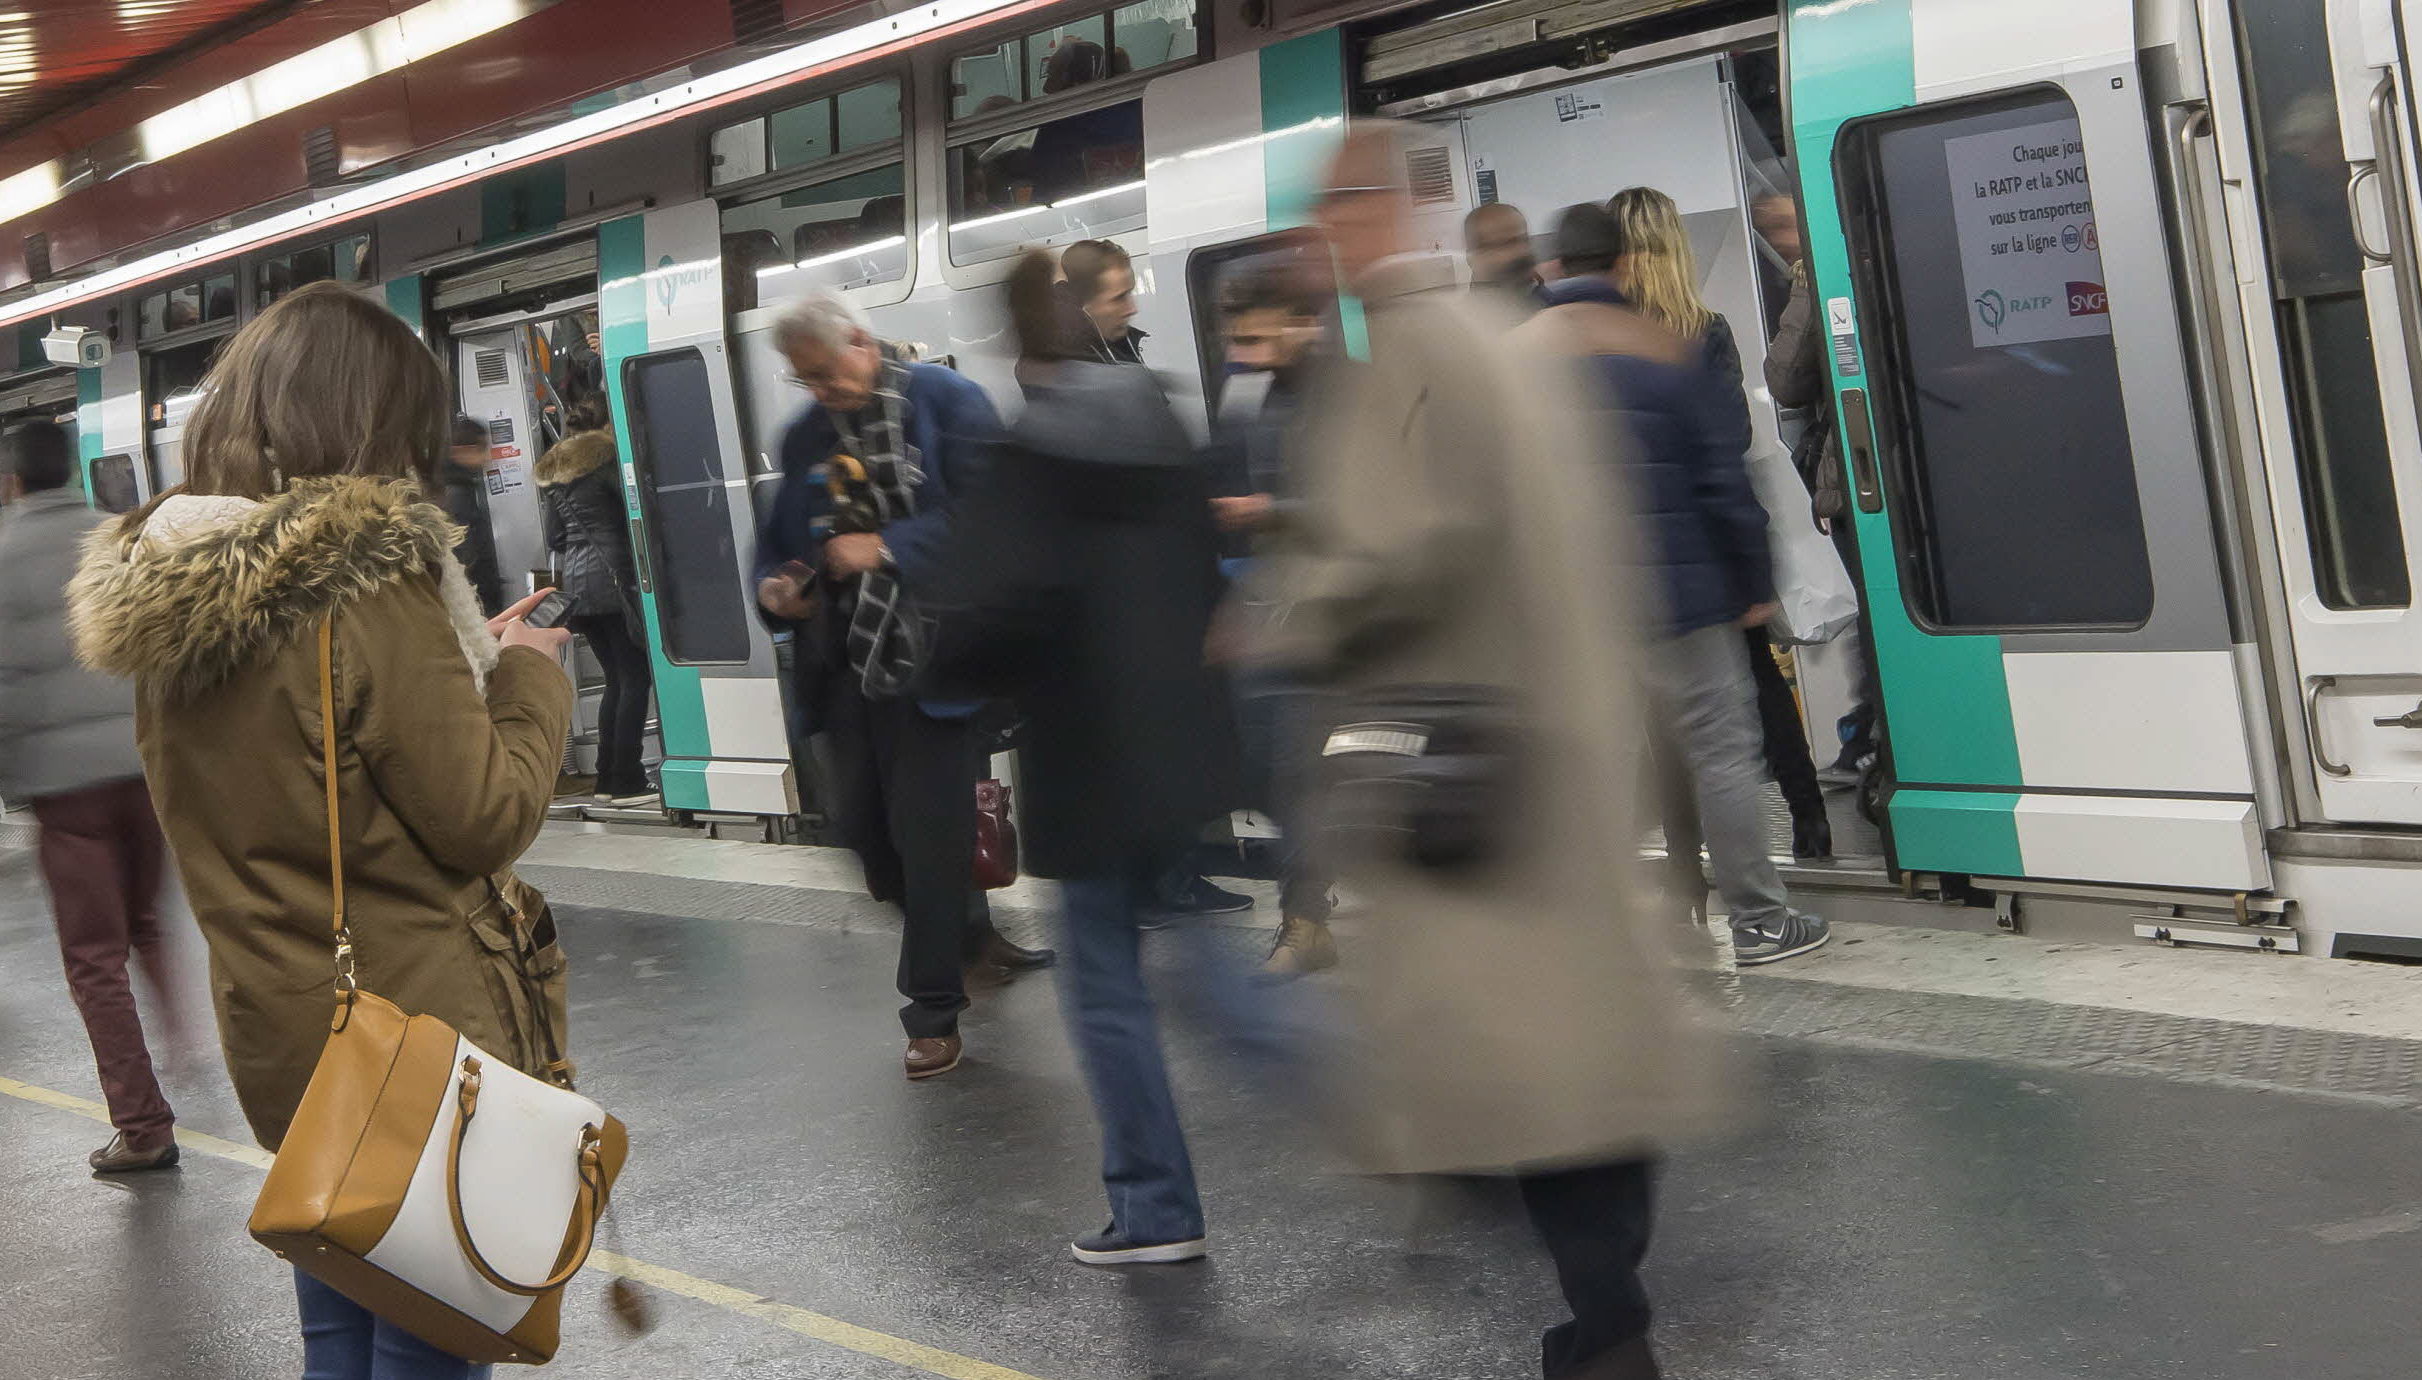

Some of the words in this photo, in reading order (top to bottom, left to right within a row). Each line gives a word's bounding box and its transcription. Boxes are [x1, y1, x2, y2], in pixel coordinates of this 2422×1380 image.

[2013, 145, 2060, 163] Chaque
[2062, 138, 2084, 160] jou
[1975, 182, 1987, 198] la
[1989, 176, 2022, 197] RATP
[2026, 176, 2039, 191] et
[2041, 172, 2053, 189] la
[1989, 212, 2016, 225] vous
[2018, 201, 2091, 222] transporten
[1991, 242, 2008, 255] sur
[2012, 236, 2024, 253] la
[2026, 233, 2057, 254] ligne
[2010, 296, 2053, 313] RATP
[2071, 292, 2106, 312] SNCF
